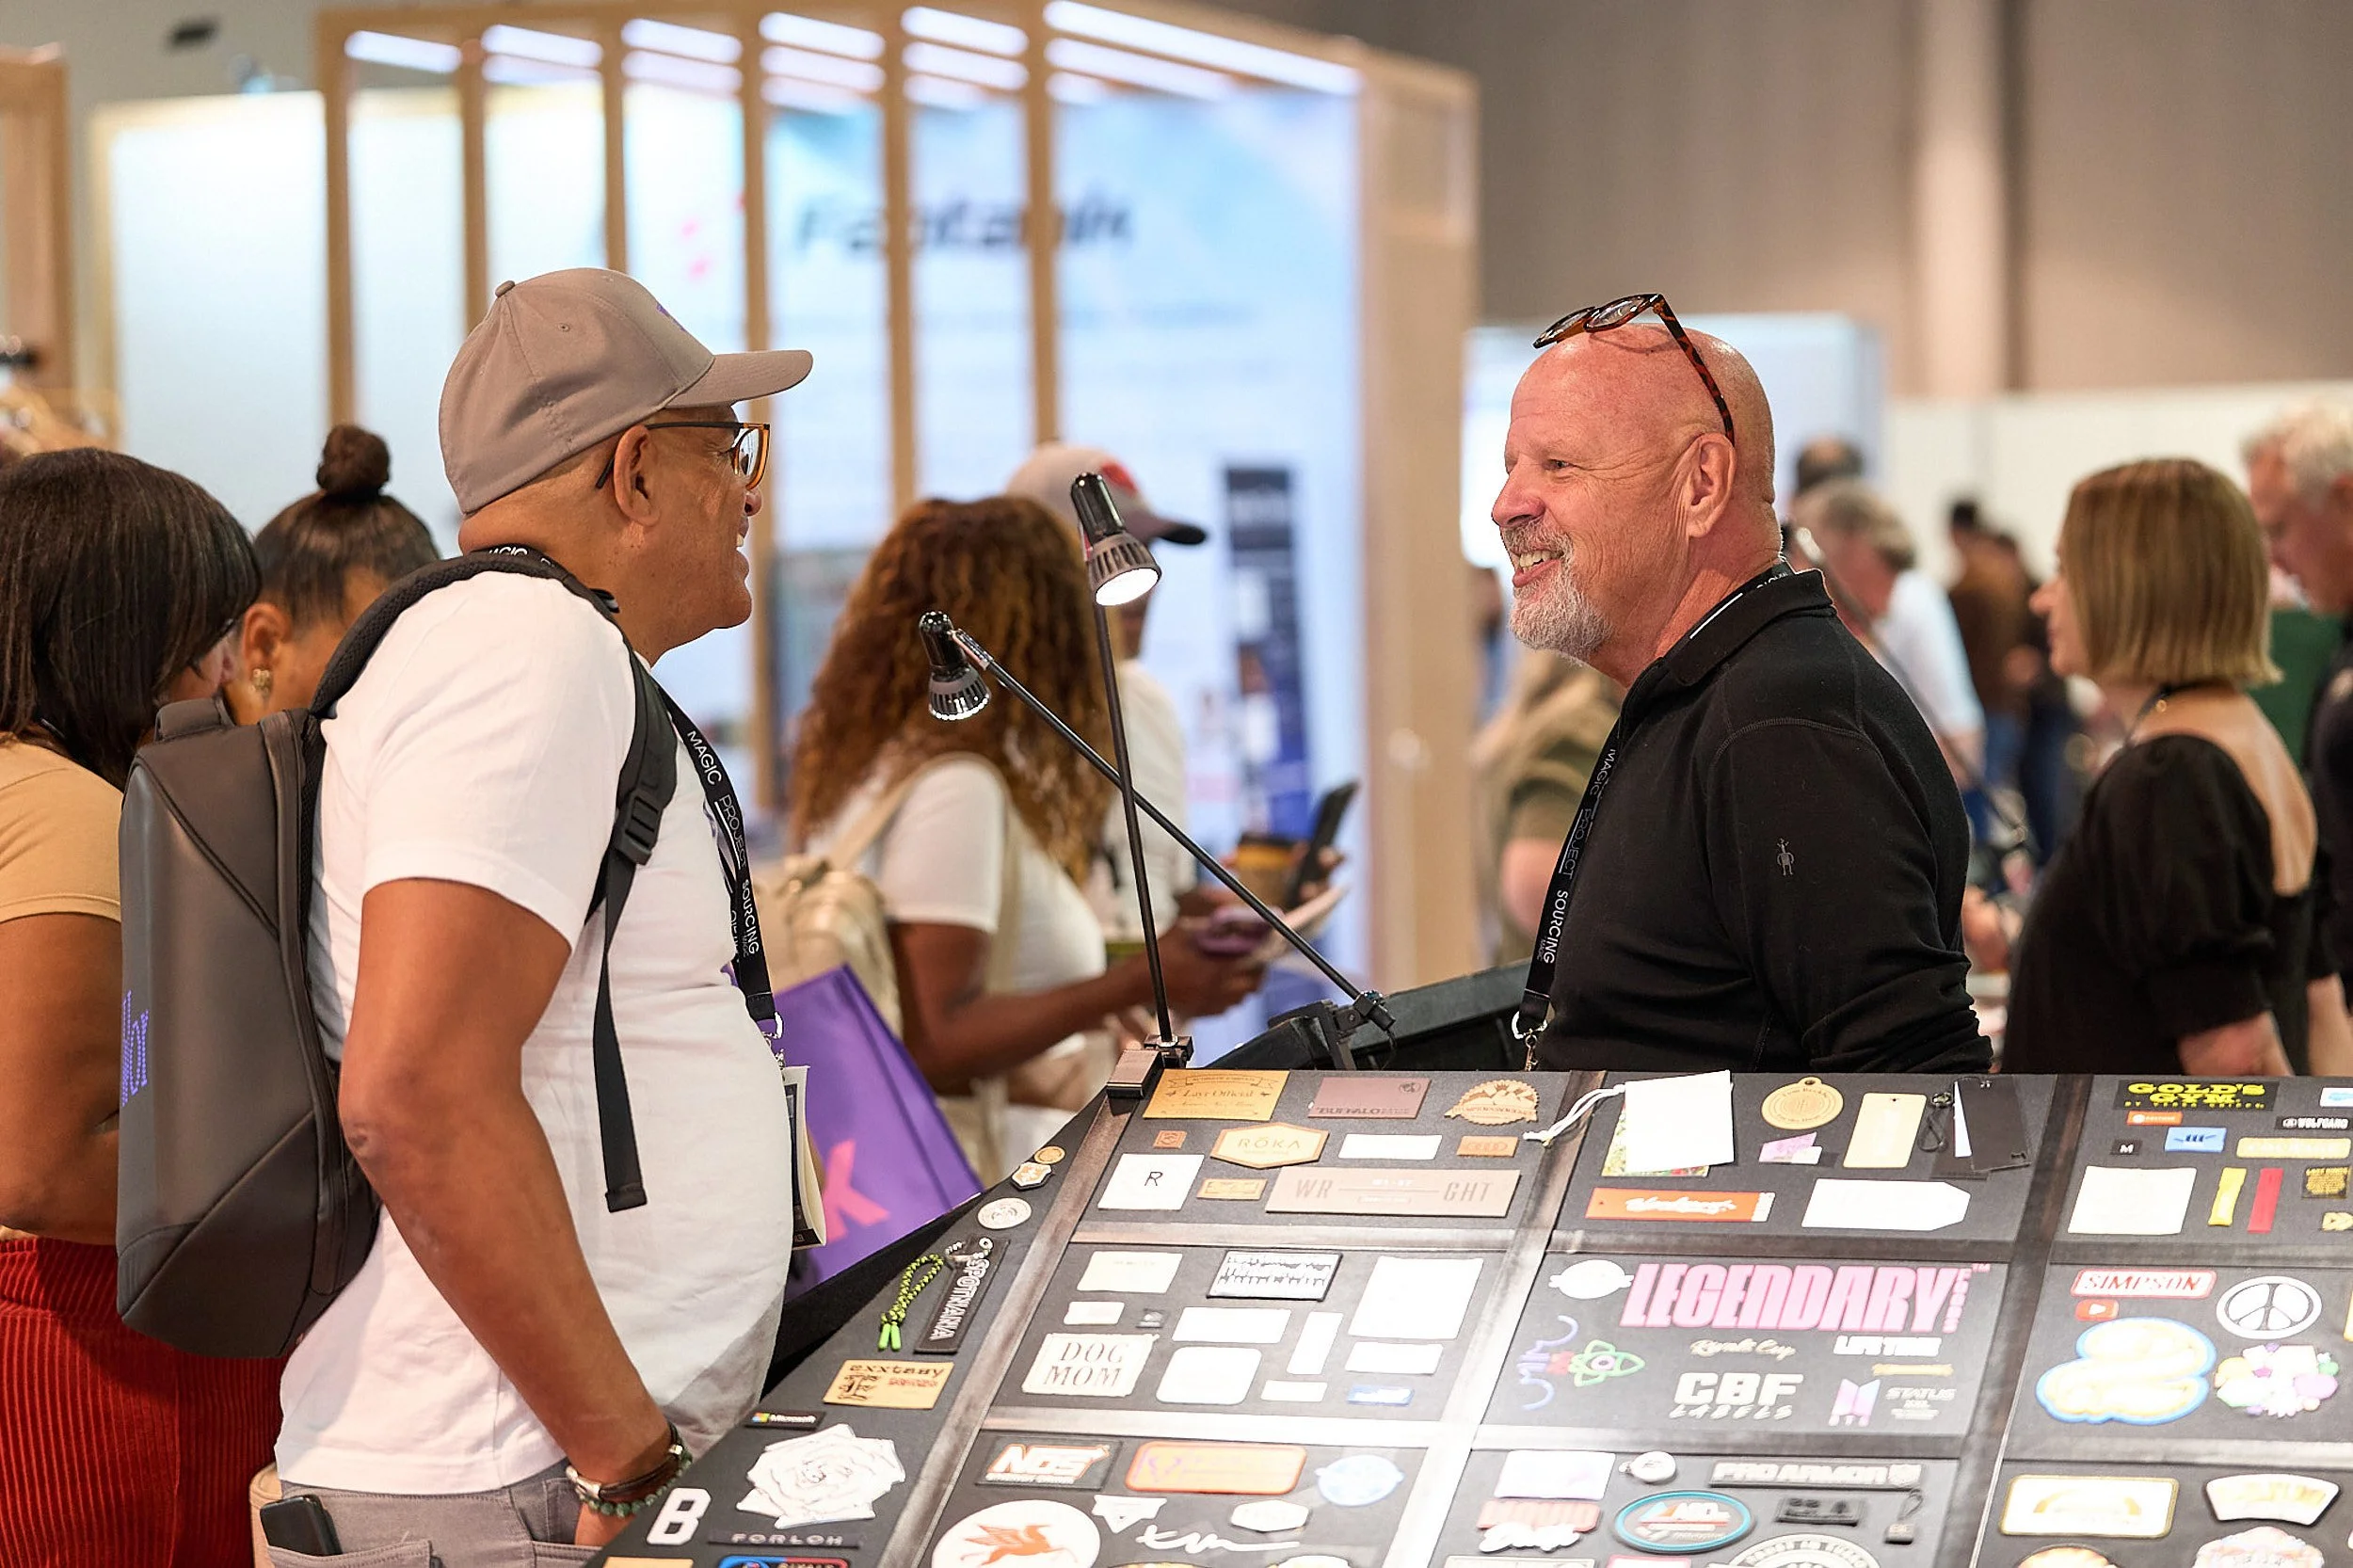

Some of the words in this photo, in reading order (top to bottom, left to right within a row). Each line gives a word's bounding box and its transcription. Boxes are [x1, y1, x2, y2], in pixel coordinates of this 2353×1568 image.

[686, 729, 722, 786] MAGIC
[1590, 749, 1616, 795] MAGIC
[719, 794, 747, 868] PROJECT
[1562, 808, 1593, 879] PROJECT
[742, 879, 760, 954] SOURCING
[1544, 889, 1569, 964] SOURCING
[2127, 1082, 2265, 1096] GOLD'S
[1144, 1171, 1163, 1187] R
[1294, 1178, 1335, 1200] WR
[1443, 1180, 1495, 1203] GHT
[929, 1259, 990, 1341] SPOTNANA
[1619, 1263, 1960, 1333] LEGENDARY
[2087, 1273, 2201, 1291] SIMPSON
[1059, 1340, 1129, 1364] DOG
[1044, 1365, 1122, 1388] MOM
[1673, 1371, 1804, 1406] CBF
[770, 1414, 817, 1424] Microsoft
[646, 1487, 712, 1545] B
[731, 1533, 843, 1546] FORLOH
